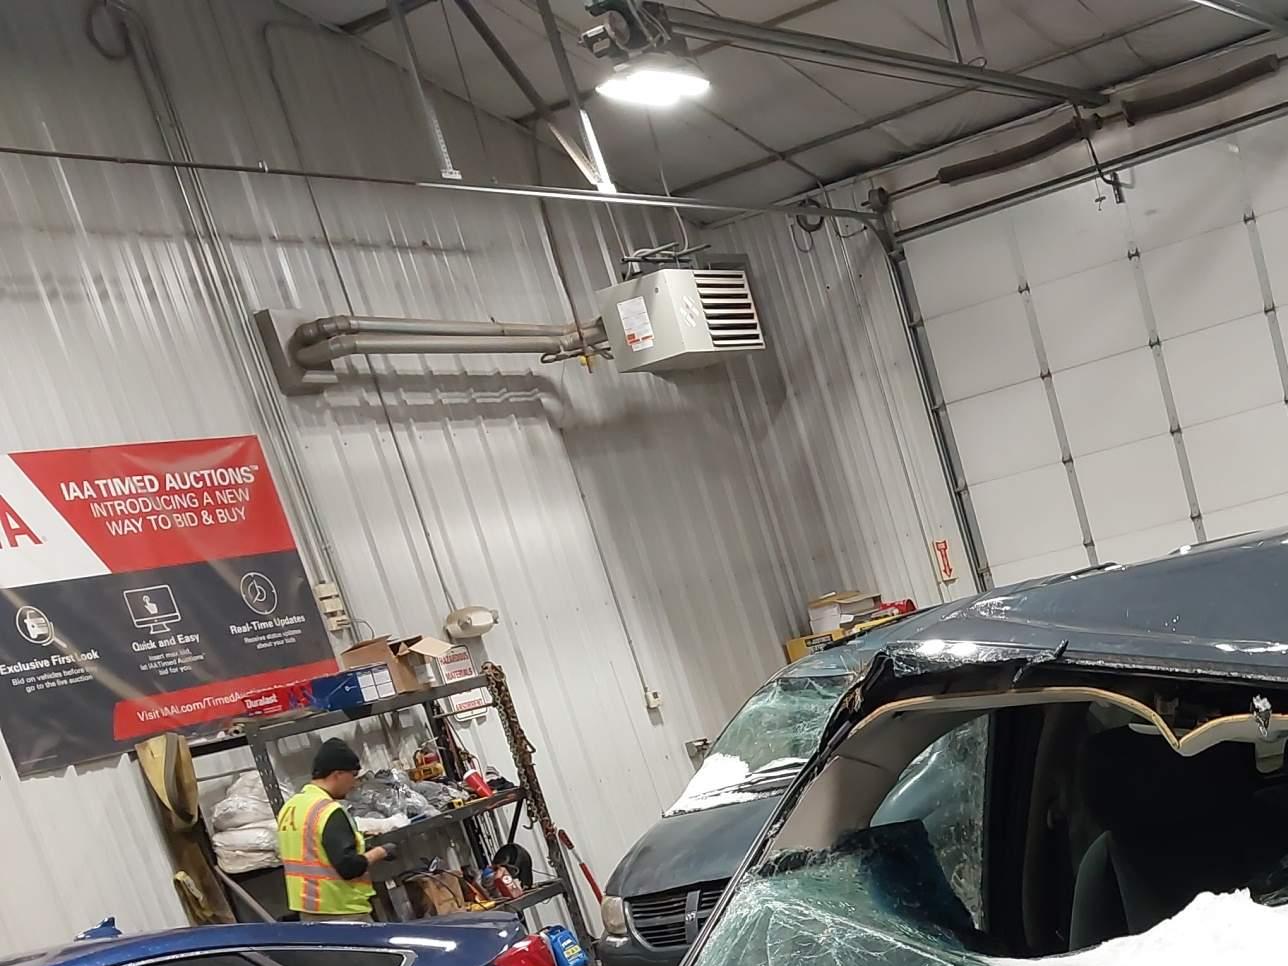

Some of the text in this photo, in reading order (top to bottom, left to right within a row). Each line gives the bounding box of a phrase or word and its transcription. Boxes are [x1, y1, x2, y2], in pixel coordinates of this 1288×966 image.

[60, 481, 97, 501] IAA
[95, 475, 159, 498] TIMED
[90, 488, 250, 518] INTRODUCING A NEW
[106, 507, 246, 536] WAY TO BID & BUY
[229, 615, 306, 635] Real-Time Updates
[132, 633, 200, 652] Quick and Easy
[0, 649, 100, 676] Exclusive First Look
[11, 677, 25, 686] Bid
[26, 675, 36, 683] on
[37, 671, 62, 681] vehicles
[63, 668, 85, 677] before
[445, 667, 473, 680] MATERIALS
[25, 685, 35, 693] go
[45, 680, 56, 689] the
[56, 678, 68, 686] live
[69, 674, 94, 684] auction
[244, 693, 279, 709] Duralast
[136, 709, 161, 722] Visit
